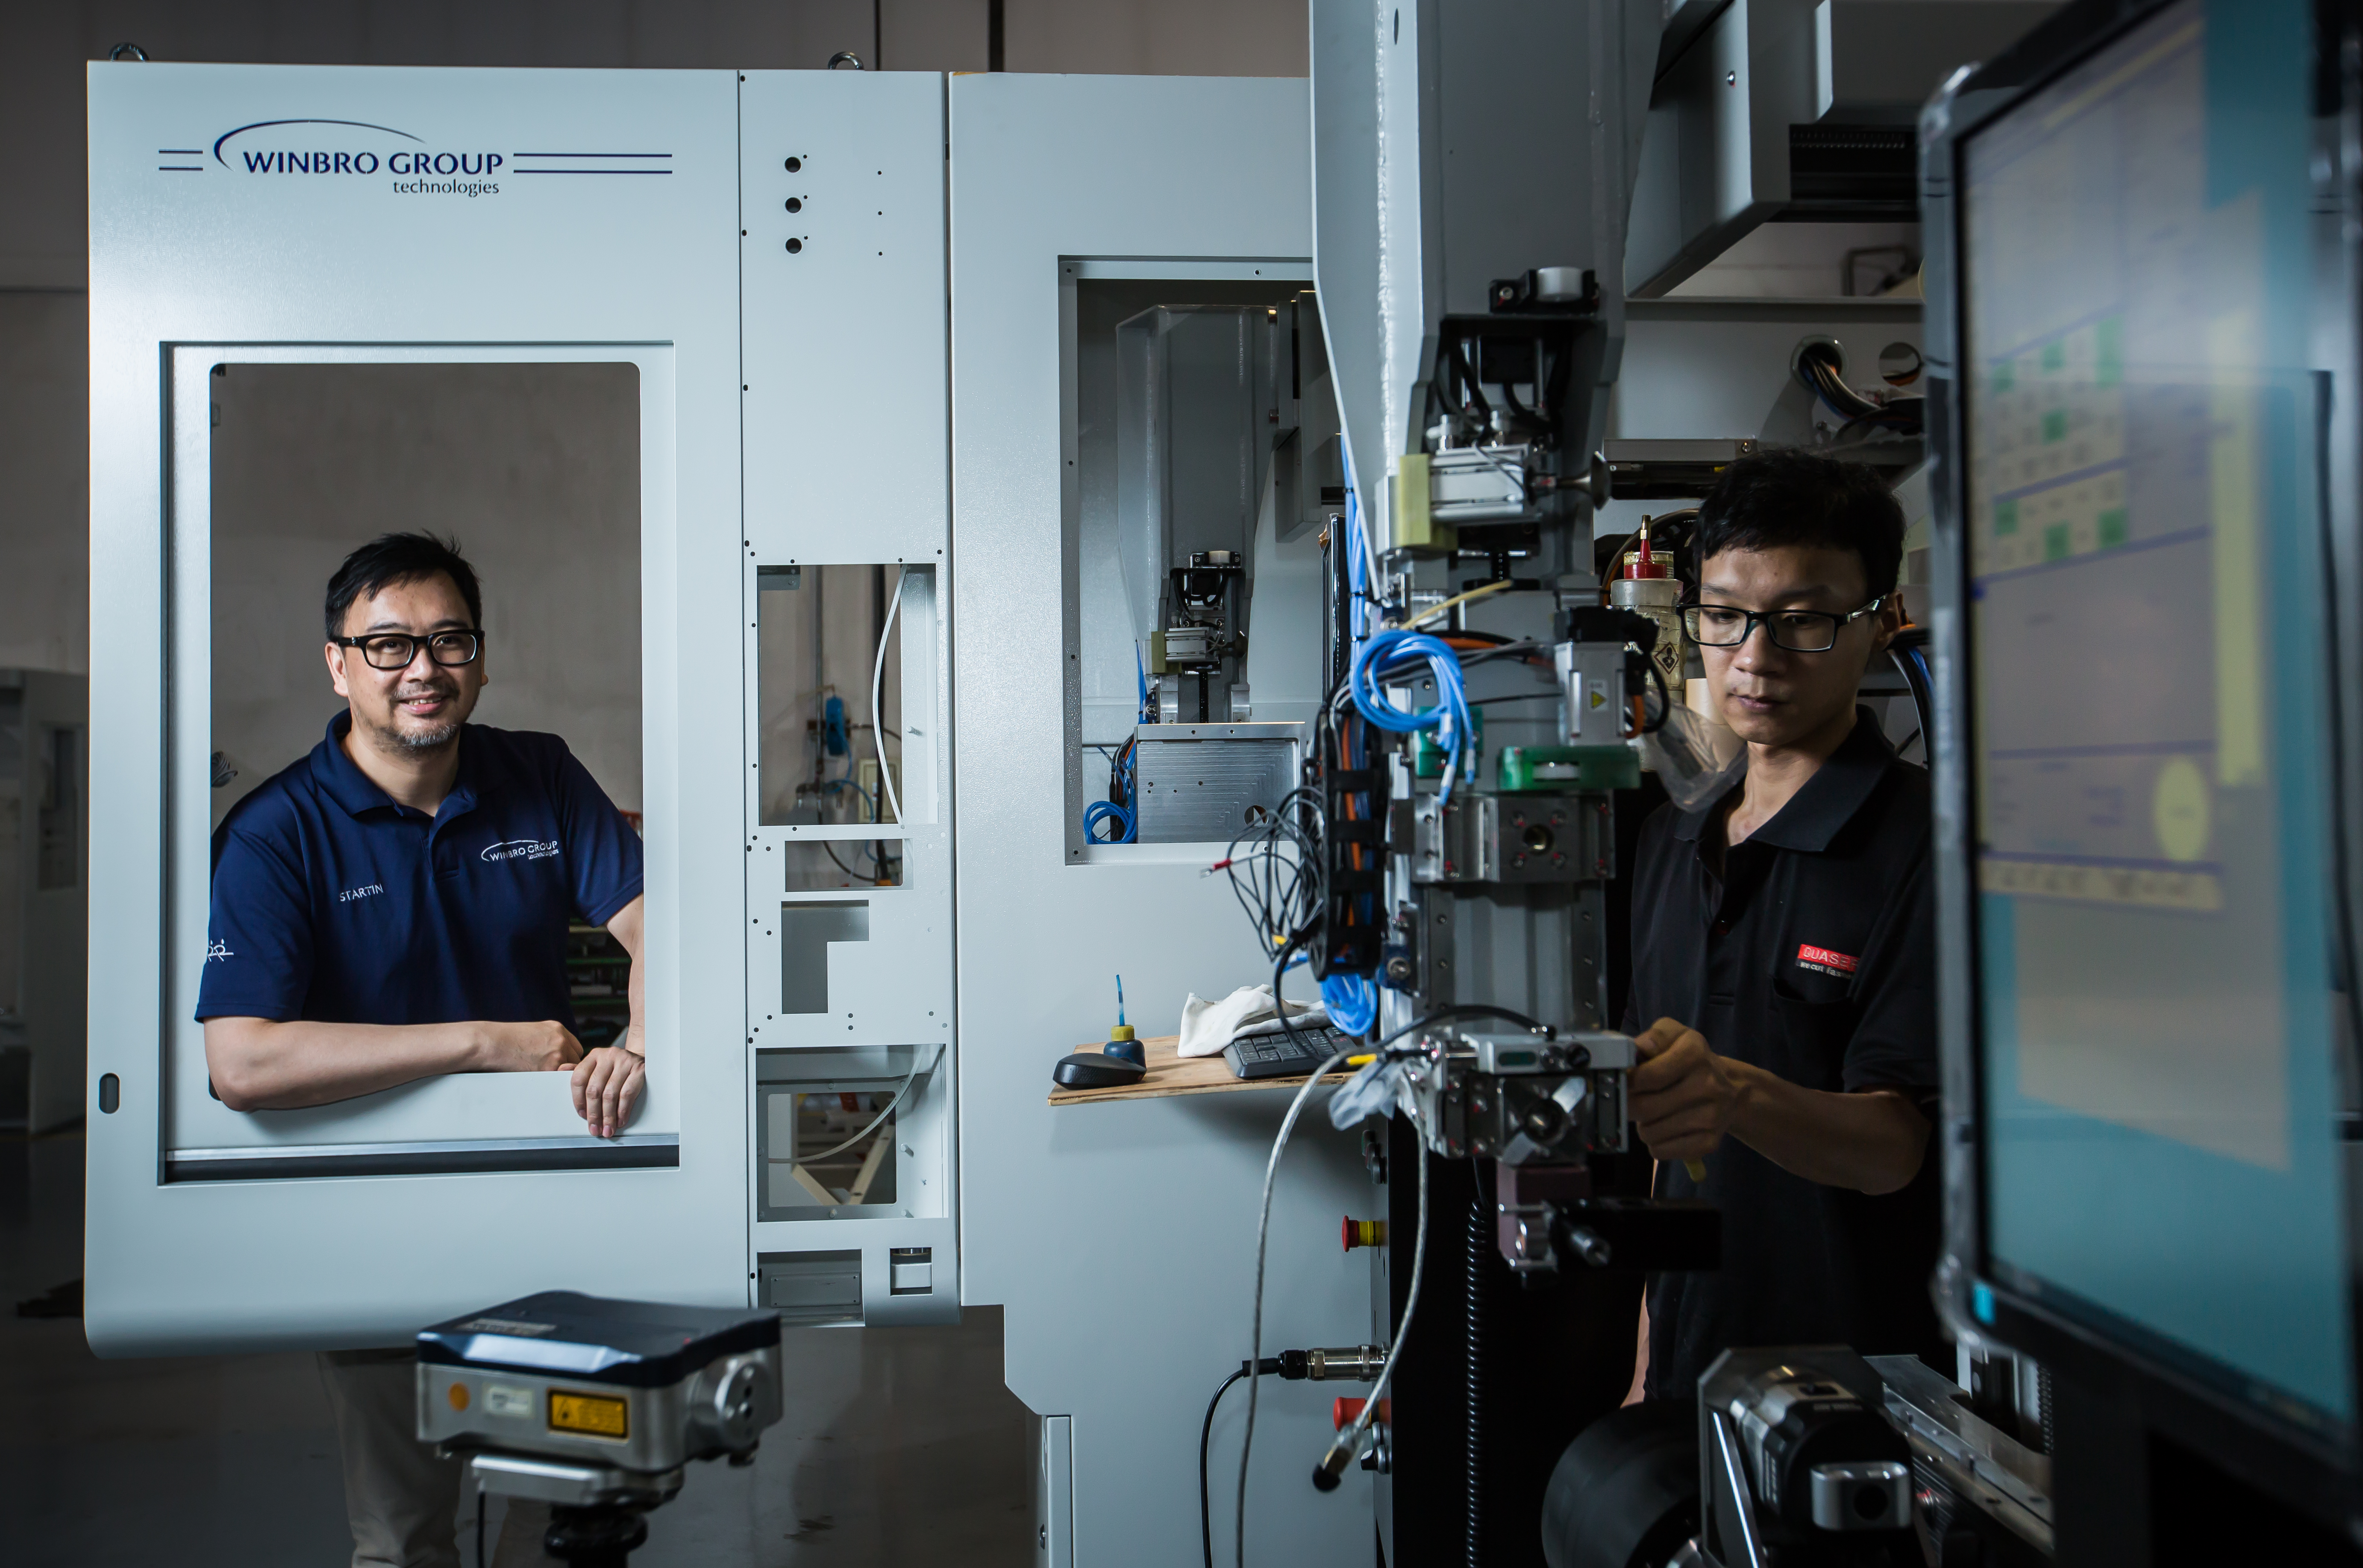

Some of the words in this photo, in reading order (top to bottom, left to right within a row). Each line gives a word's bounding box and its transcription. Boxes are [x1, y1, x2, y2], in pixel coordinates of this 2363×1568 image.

[243, 151, 379, 175] WINBRO
[388, 152, 503, 175] GROUP
[394, 178, 500, 198] technologies
[490, 848, 526, 861] WINBRO
[528, 841, 557, 854] GROUP
[527, 849, 559, 860] technologies
[340, 883, 384, 901] STARTIN
